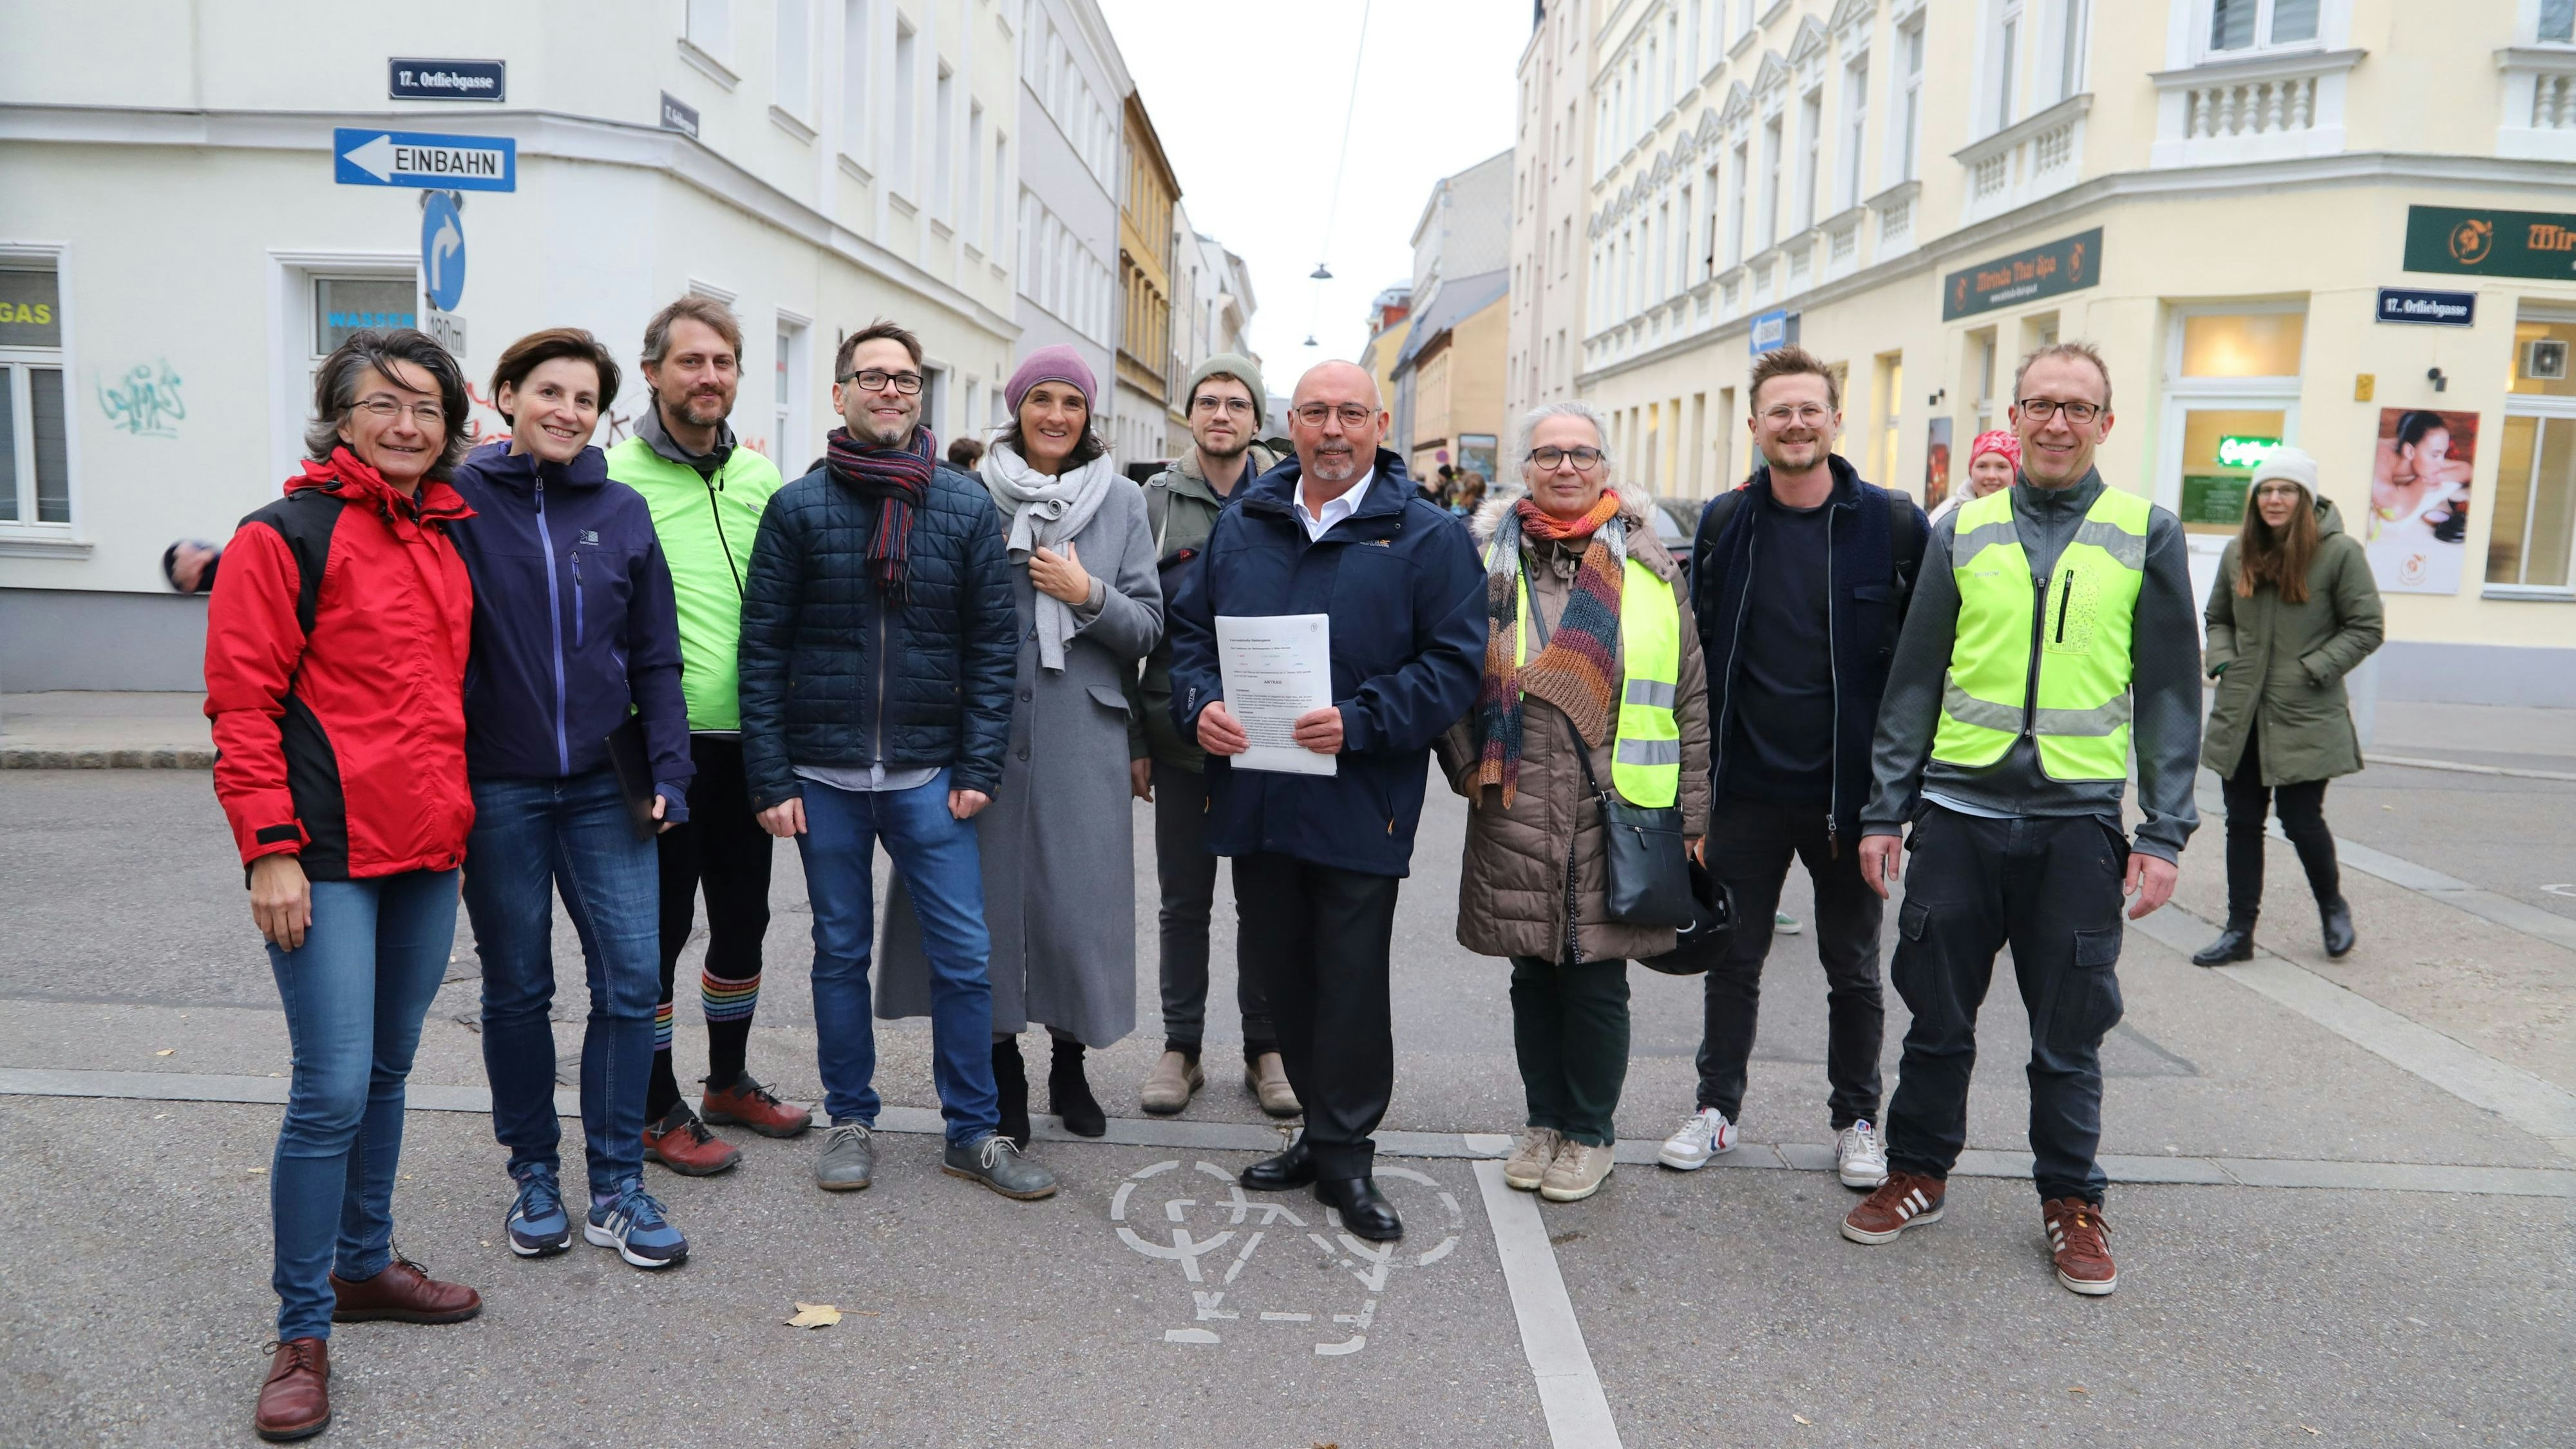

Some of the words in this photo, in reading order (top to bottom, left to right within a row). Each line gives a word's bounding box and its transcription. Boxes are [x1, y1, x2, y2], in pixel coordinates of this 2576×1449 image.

[420, 71, 495, 91] Ortliebgasse
[395, 147, 495, 175] EINBAHN
[2036, 254, 2056, 279] Spa
[0, 302, 52, 325] GAS
[2403, 299, 2468, 318] Ortliebgasse
